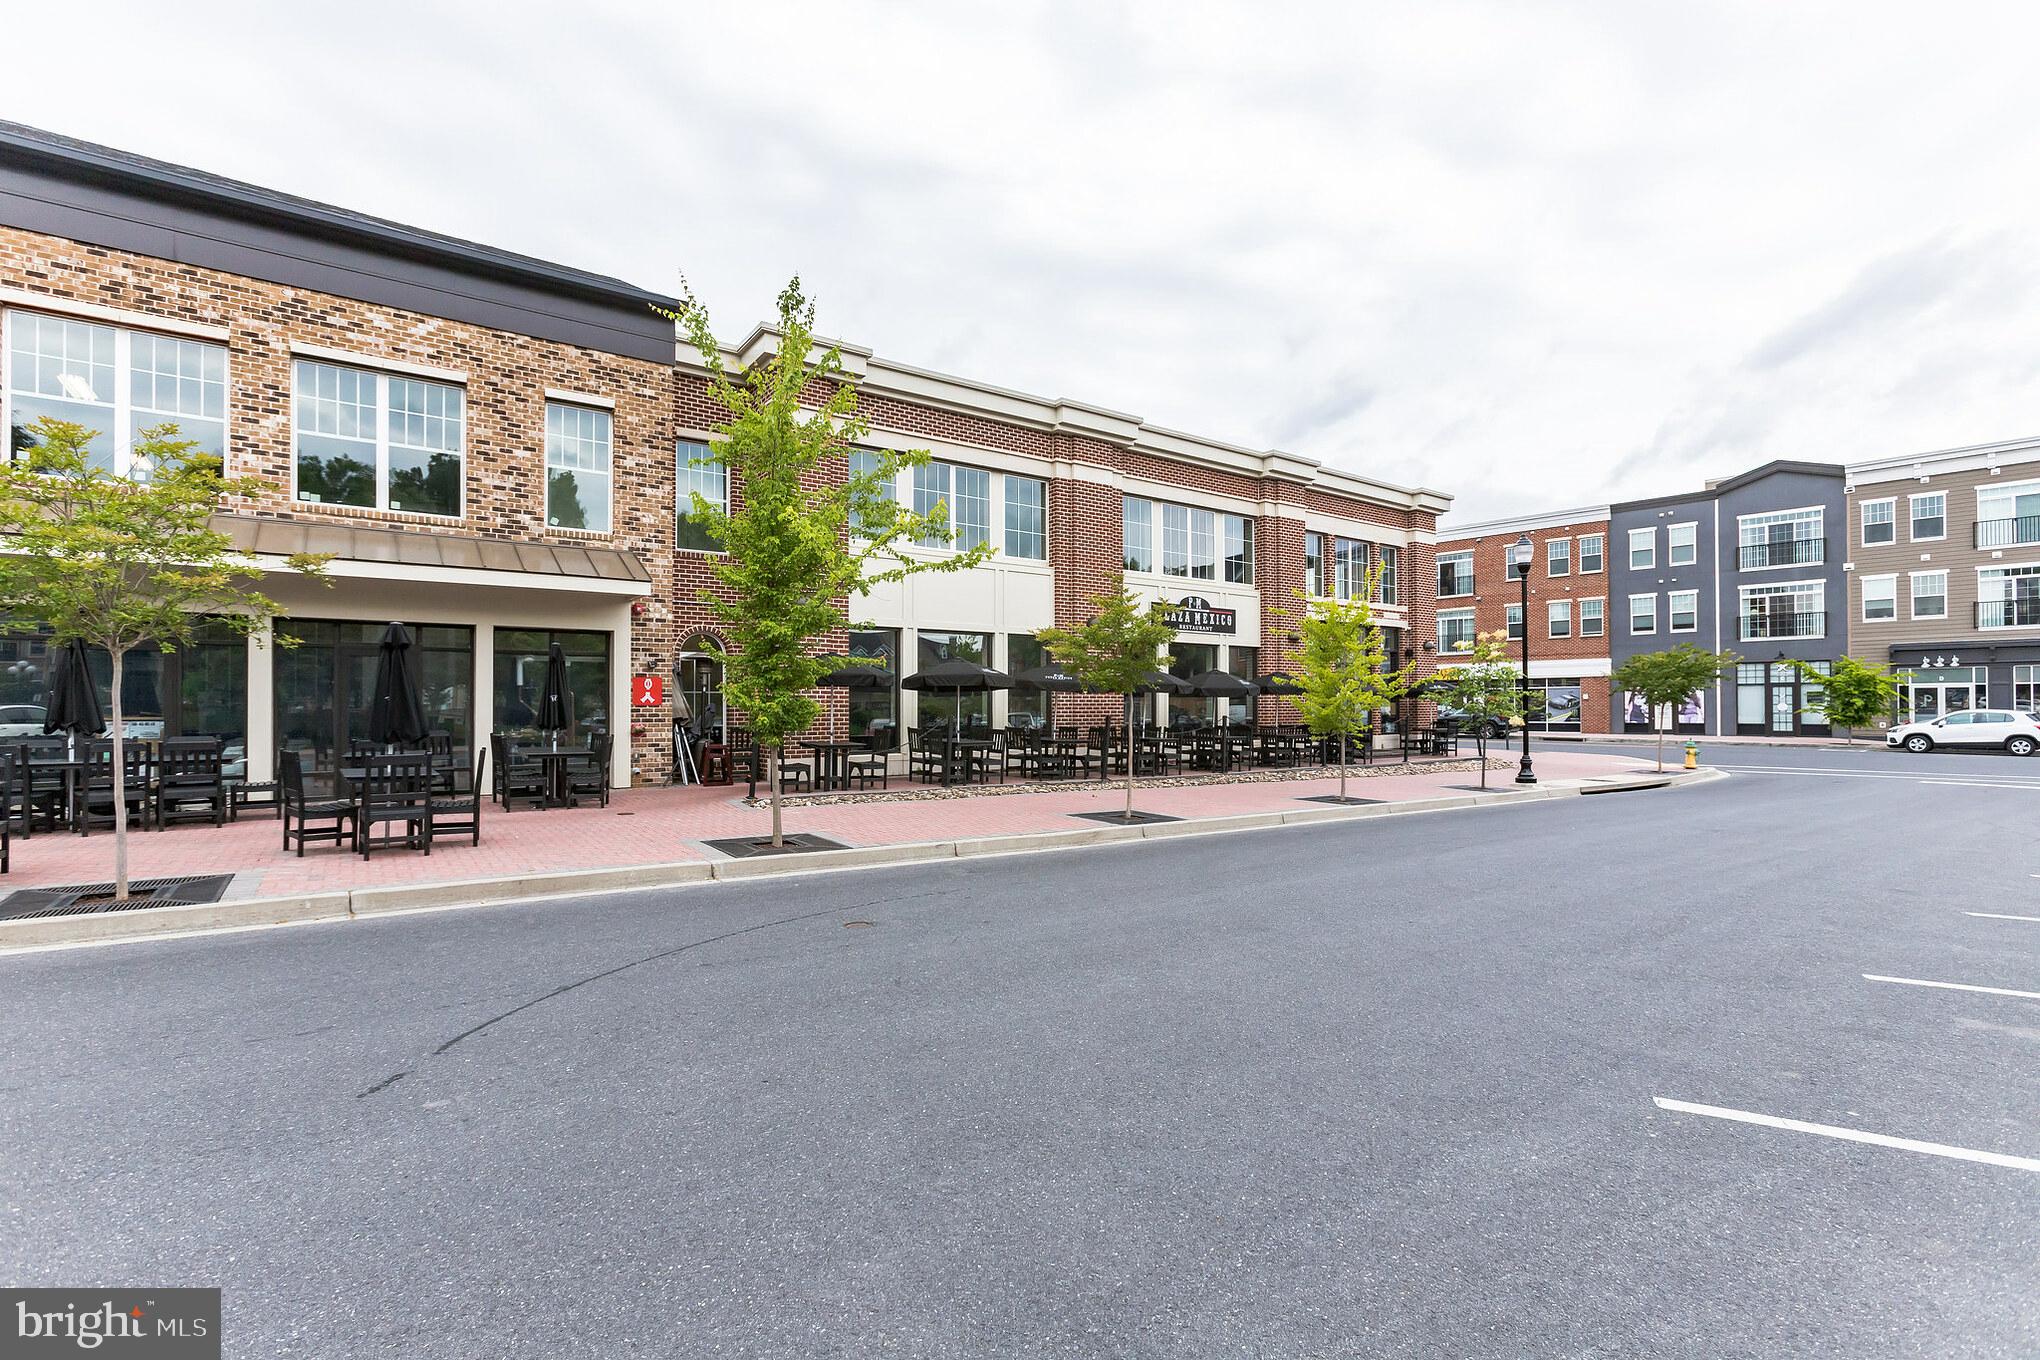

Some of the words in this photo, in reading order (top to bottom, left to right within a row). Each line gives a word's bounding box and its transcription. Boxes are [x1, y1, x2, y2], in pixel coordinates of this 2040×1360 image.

[1162, 610, 1190, 623] LAZA
[1194, 612, 1232, 626] MEXICO
[1179, 624, 1213, 632] RESTAURANT
